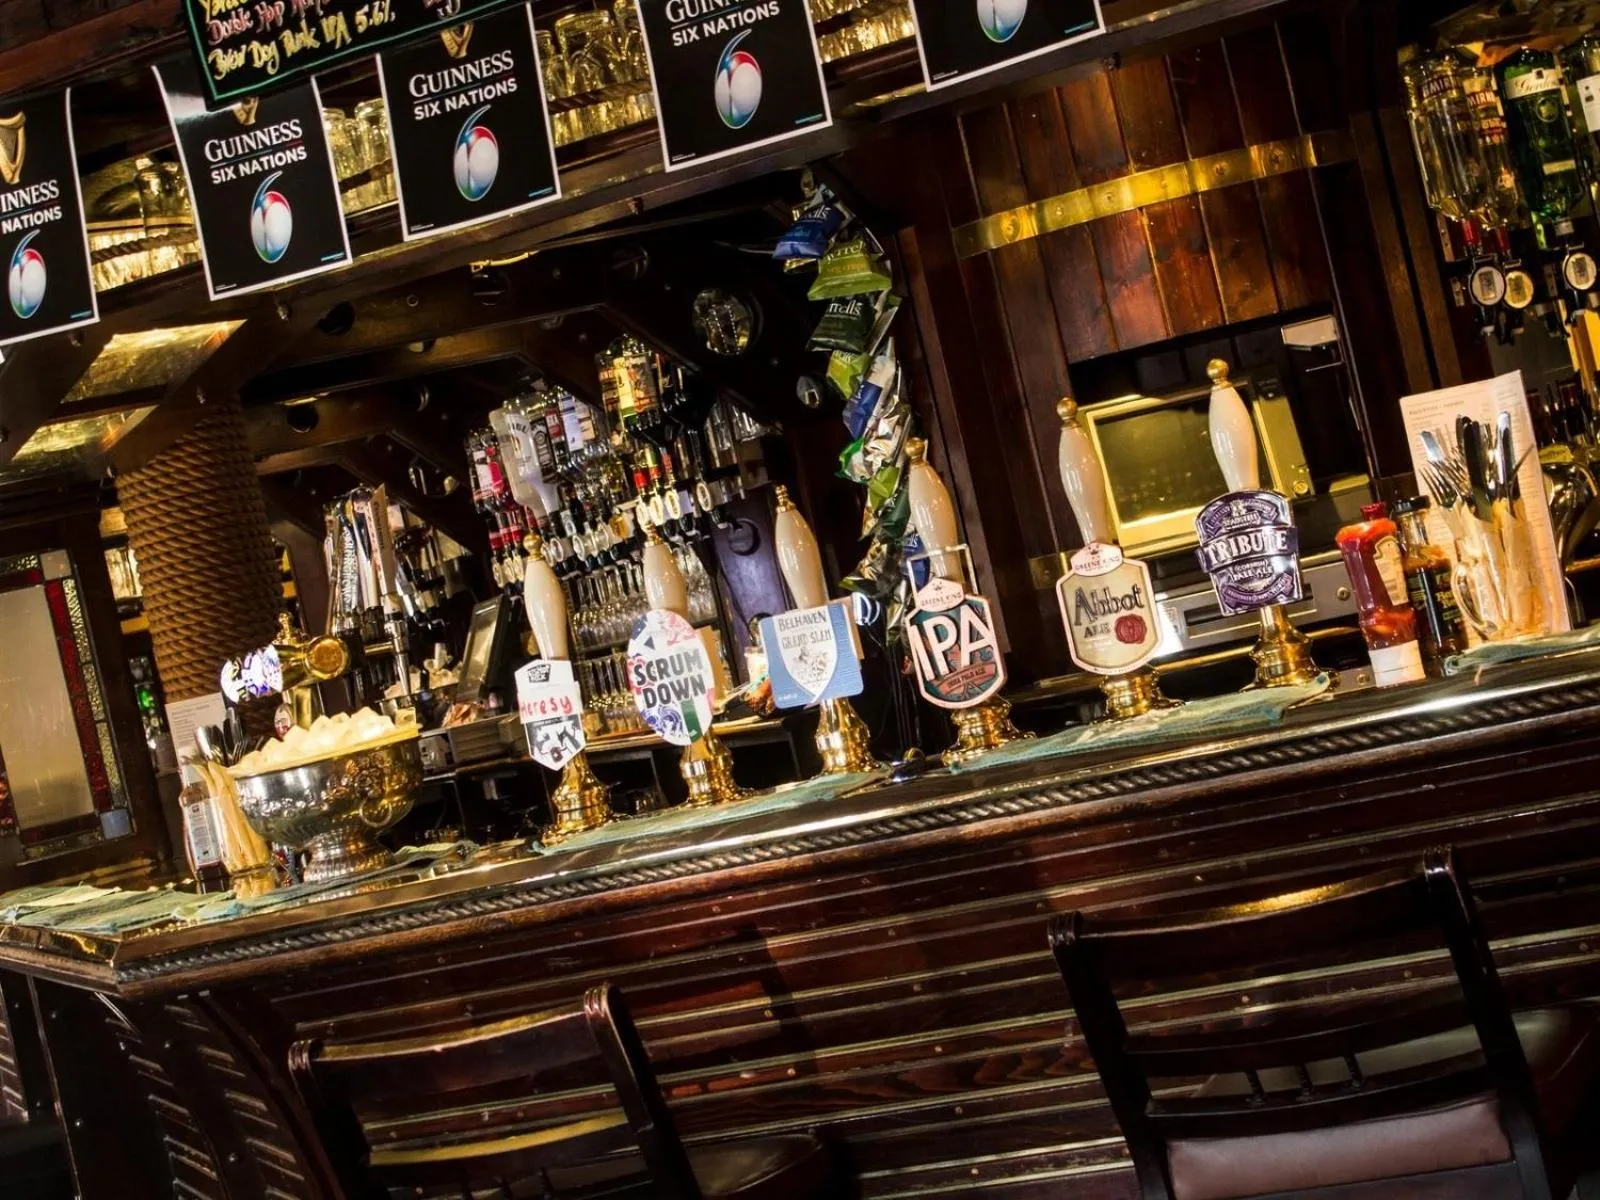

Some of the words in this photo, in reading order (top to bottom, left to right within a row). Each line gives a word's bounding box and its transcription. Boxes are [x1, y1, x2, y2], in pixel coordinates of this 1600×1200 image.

[255, 1, 285, 33] Hop
[665, 0, 743, 23] GUIN
[672, 25, 700, 47] SIX
[703, 1, 780, 37] NATIONS
[208, 42, 246, 80] Brew
[249, 39, 279, 75] Dog
[278, 20, 321, 58] Punk
[409, 50, 515, 97] GUINNESS
[414, 101, 441, 120] SIX
[444, 78, 518, 112] NATIONS
[204, 119, 303, 162] GUINNESS
[211, 165, 236, 185] SIX
[238, 146, 308, 177] NATIONS
[0, 179, 60, 213] INNESS
[1, 206, 63, 235] NATIONS
[829, 300, 863, 316] rrells
[1204, 530, 1288, 566] TRIBUTE
[778, 610, 827, 632] BELHAVEN
[1074, 583, 1144, 626] Abbot
[909, 604, 994, 681] IPA
[634, 649, 703, 687] SCRUM
[642, 674, 706, 709] DOWN
